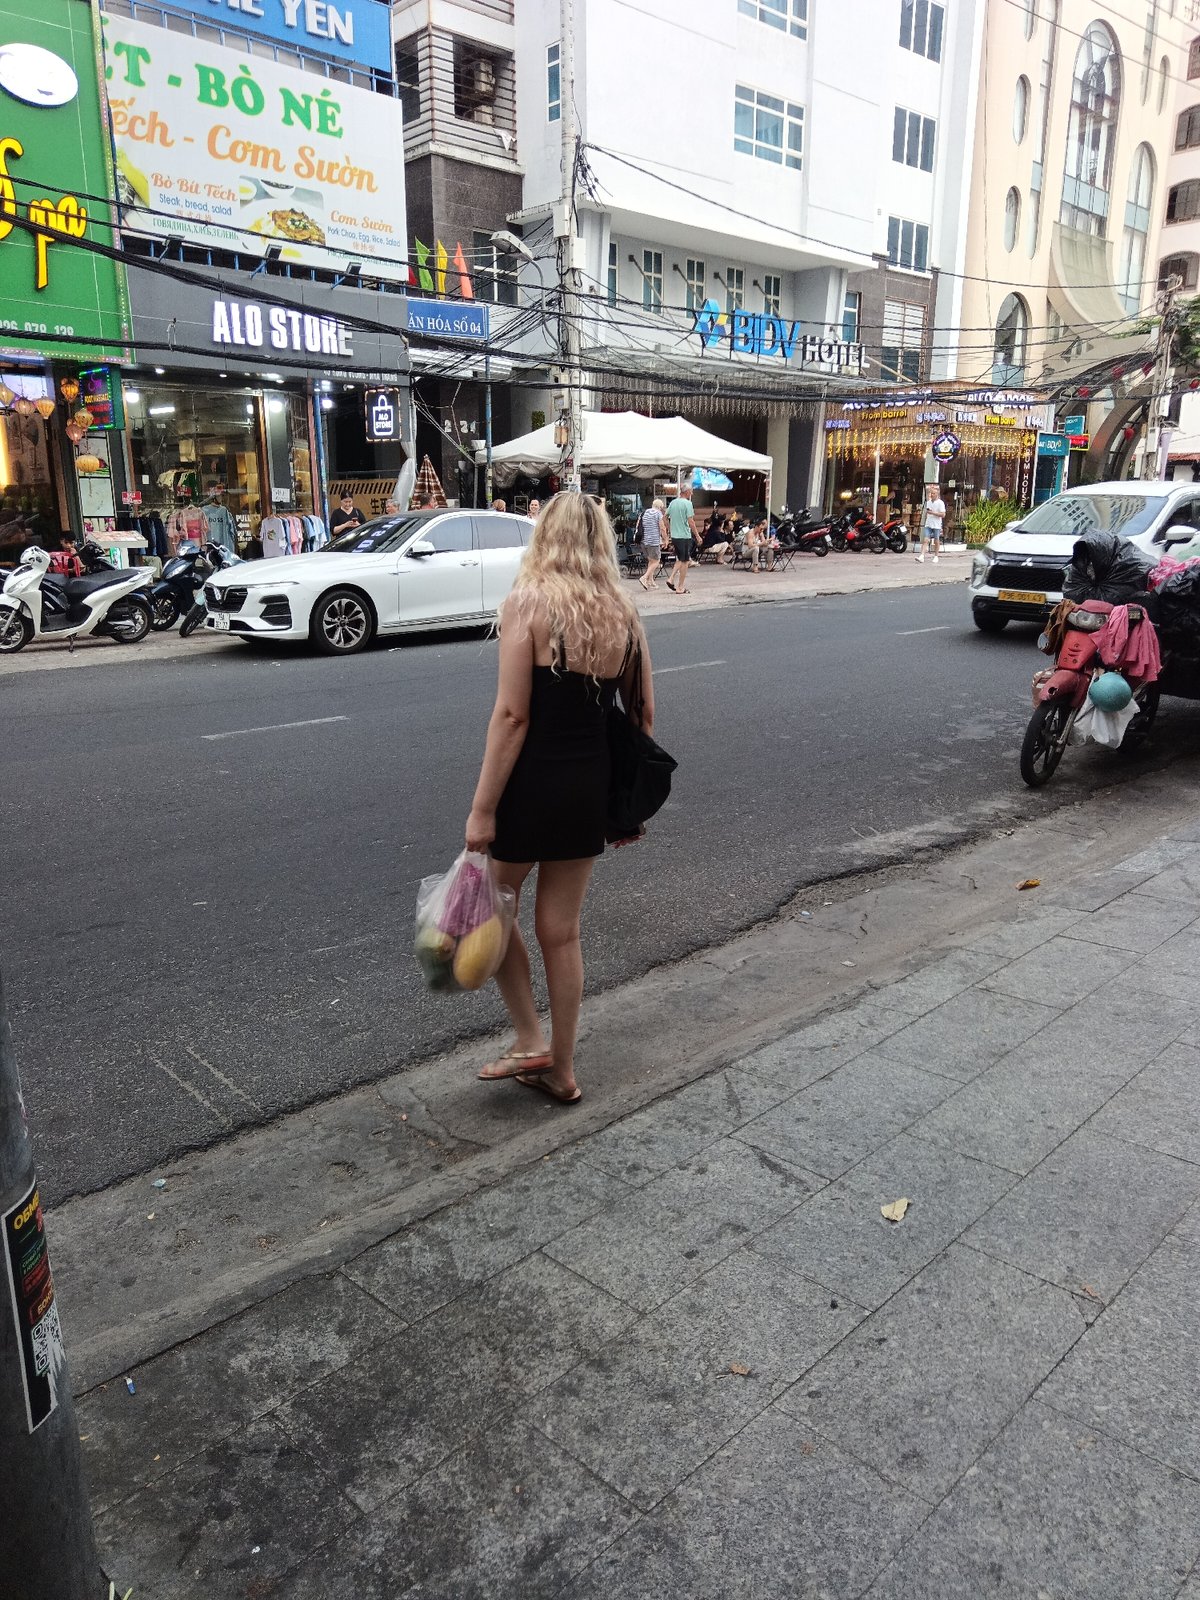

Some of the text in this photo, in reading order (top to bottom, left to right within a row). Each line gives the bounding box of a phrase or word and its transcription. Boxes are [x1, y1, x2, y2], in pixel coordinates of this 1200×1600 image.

[195, 63, 265, 116] BÒ
[278, 87, 344, 139] NÉ
[109, 97, 175, 148] ếch
[207, 124, 286, 173] Cơm
[293, 145, 379, 194] Sườn
[151, 172, 238, 202] Bò Bít Tếch
[211, 205, 232, 216] salad
[213, 300, 354, 356] ALO STORE
[427, 313, 452, 331] HÓA
[453, 315, 468, 333] SỐ
[470, 321, 482, 334] 04
[731, 308, 872, 369] BIDV HOTEL
[375, 413, 392, 429] ALO STORE
